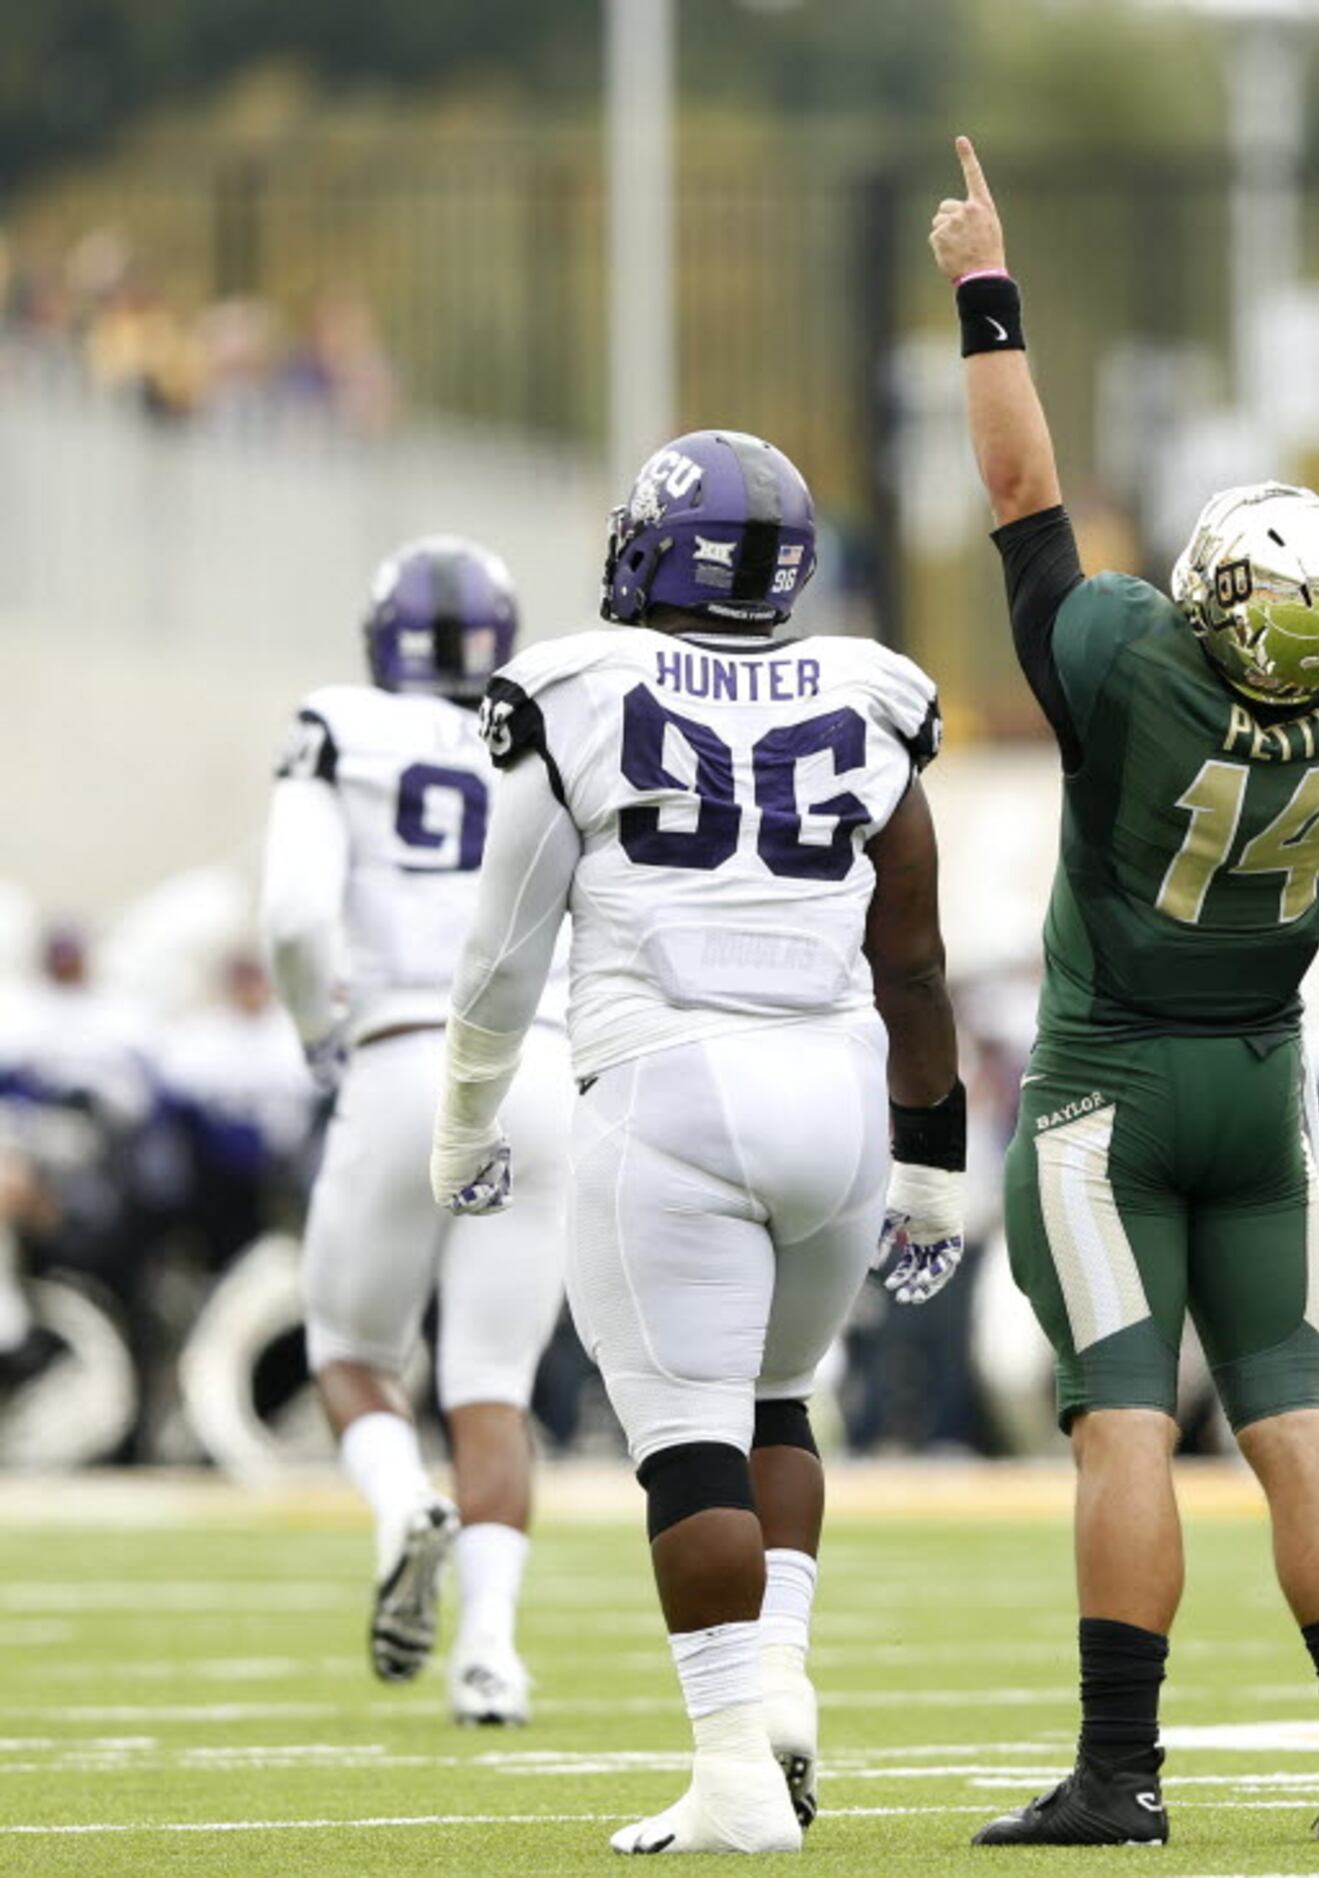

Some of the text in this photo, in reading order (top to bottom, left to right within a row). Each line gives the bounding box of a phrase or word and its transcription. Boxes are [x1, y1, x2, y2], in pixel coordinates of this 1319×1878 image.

[772, 567, 798, 593] 96
[656, 651, 820, 701] HUNTER
[618, 681, 873, 882] 96
[395, 762, 489, 872] 9
[1036, 1090, 1106, 1130] BAYLOR
